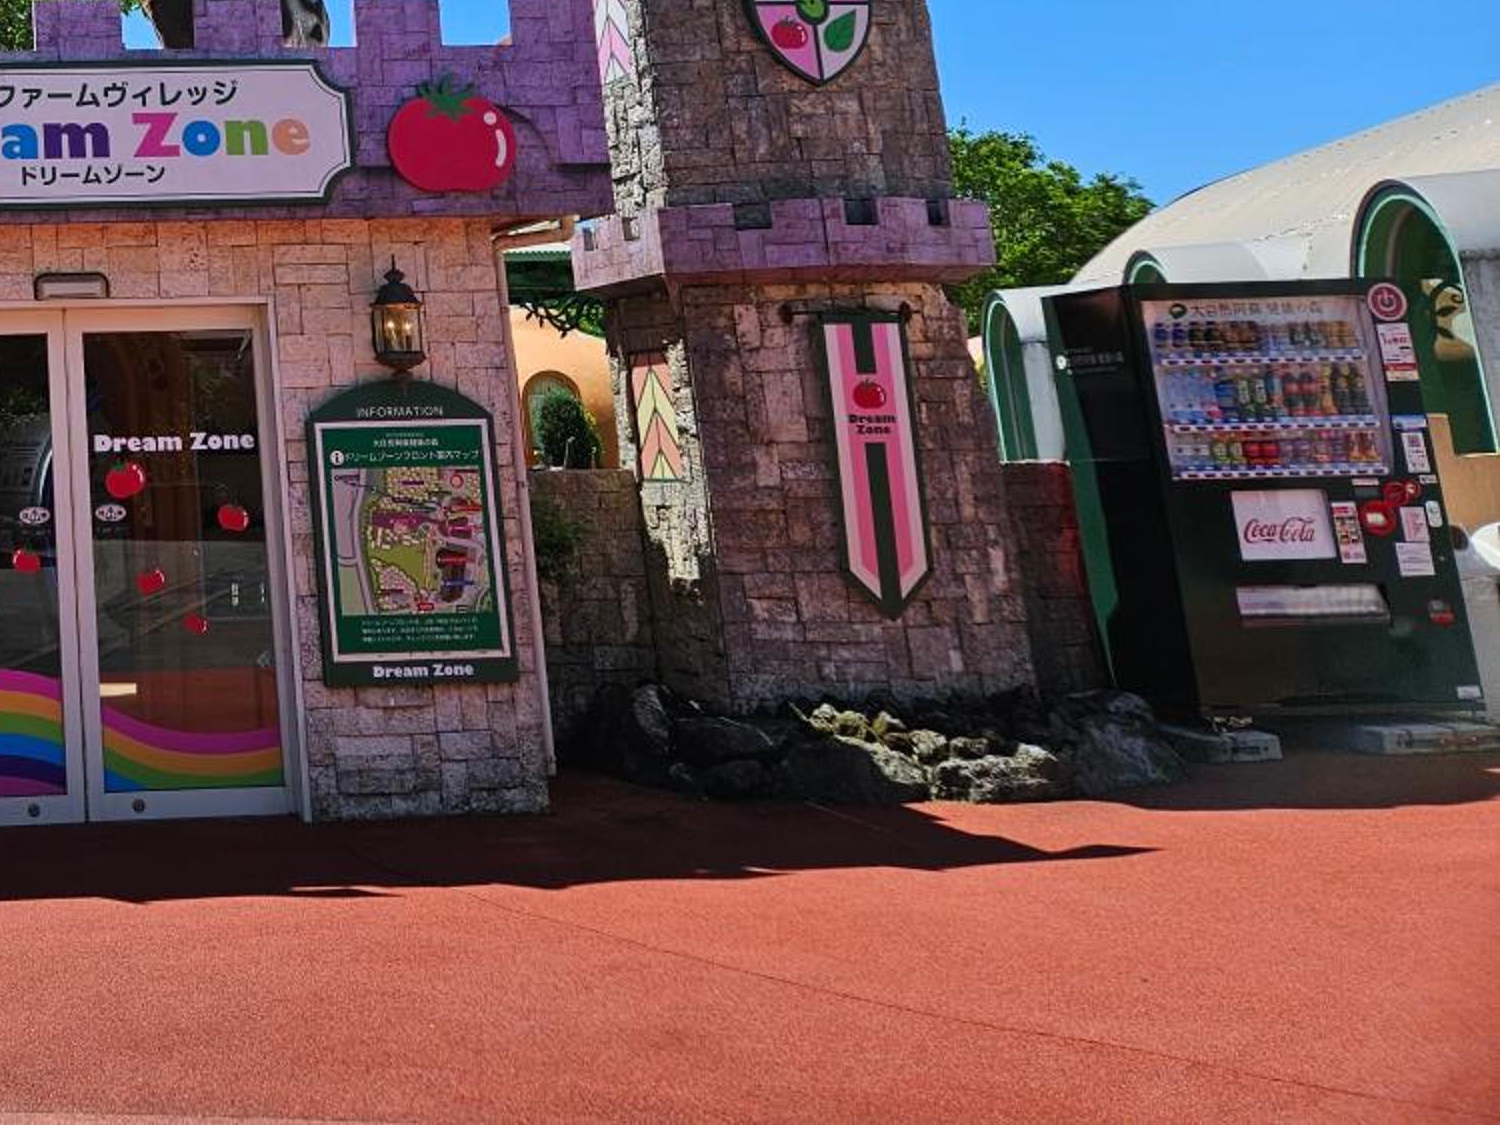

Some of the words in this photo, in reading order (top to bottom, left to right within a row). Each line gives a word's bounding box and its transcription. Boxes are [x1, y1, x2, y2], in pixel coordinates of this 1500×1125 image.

[132, 112, 311, 160] Zone
[19, 165, 165, 187] ドリームゾーン
[356, 406, 443, 419] INFORMATION
[848, 414, 897, 424] Dream
[857, 424, 891, 434] Zone
[94, 432, 183, 453] Dream
[190, 431, 255, 451] Zone
[373, 664, 429, 679] Dream
[433, 663, 475, 677] Zone
